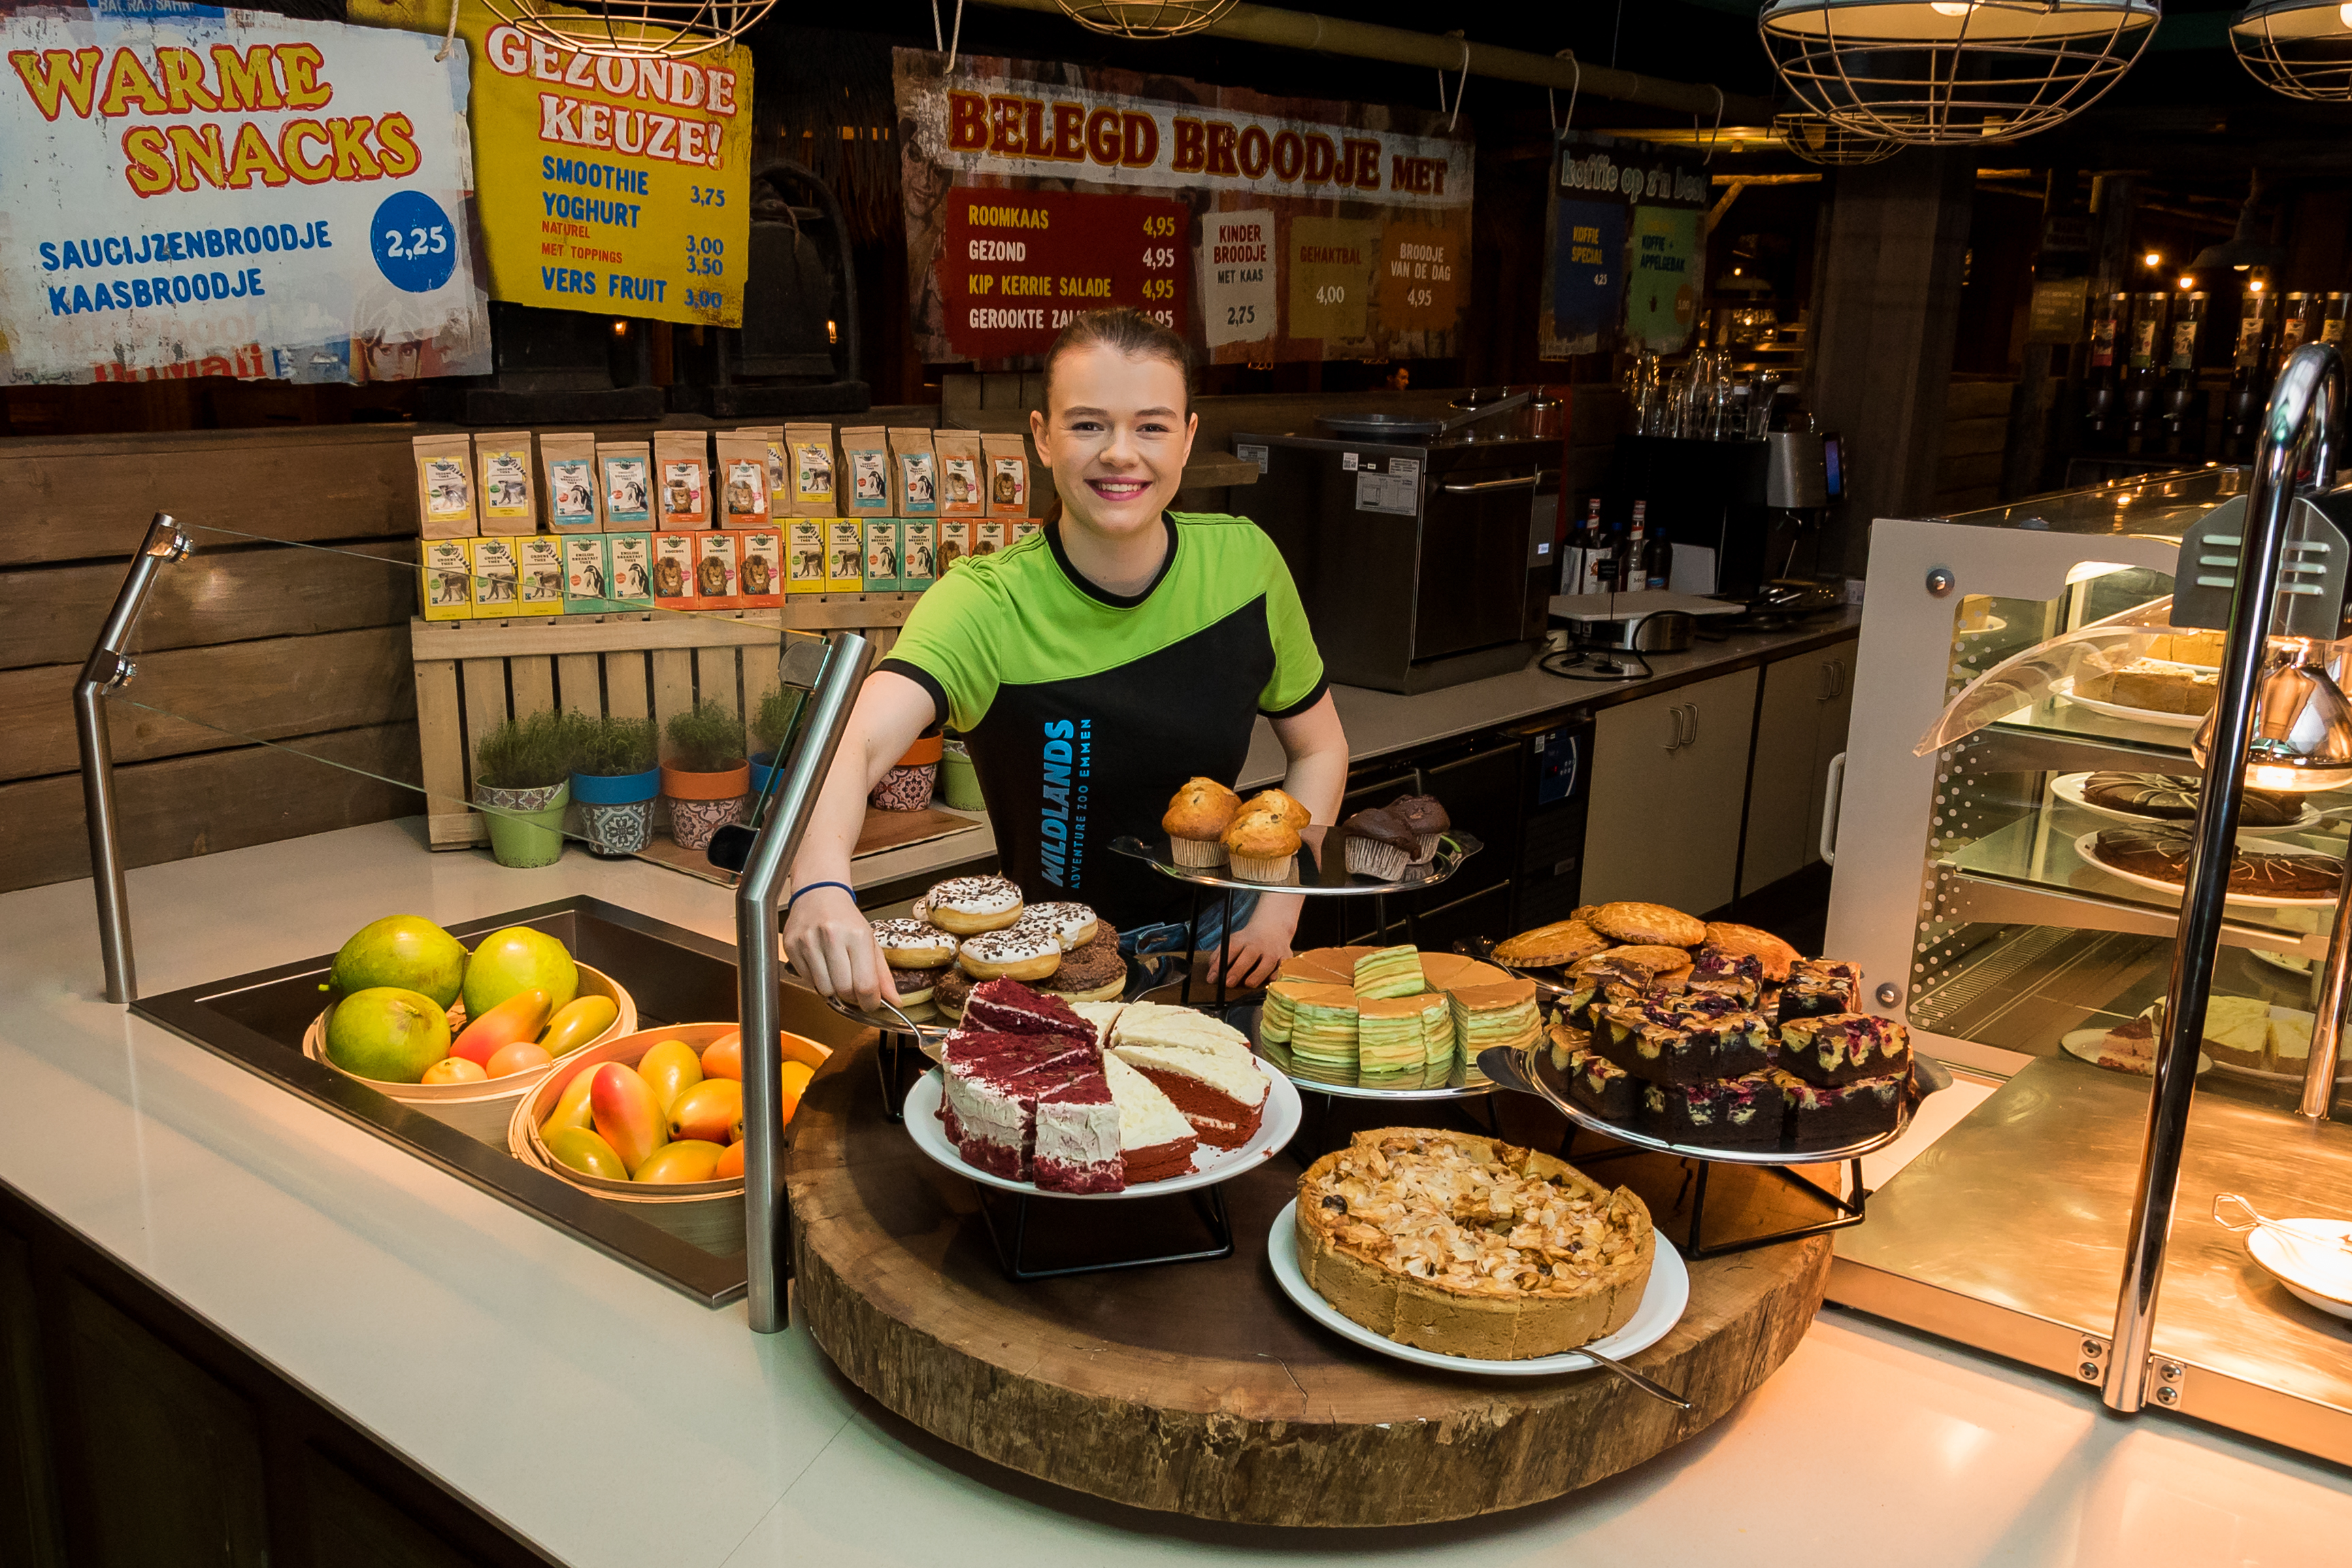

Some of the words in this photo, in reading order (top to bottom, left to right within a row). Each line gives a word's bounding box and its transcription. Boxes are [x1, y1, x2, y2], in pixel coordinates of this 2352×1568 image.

[484, 23, 737, 117] GEZONDE
[8, 41, 333, 122] WARME
[538, 91, 724, 170] KEUZE!
[947, 88, 1159, 169] BELEGD
[1172, 116, 1382, 191] BROODJE
[1391, 154, 1448, 195] MET
[121, 112, 421, 198] SNACKS
[542, 155, 649, 196] SMOOTHIE
[1621, 167, 1644, 204] op
[690, 186, 725, 207] 3,75
[542, 191, 641, 229] YOGHURT
[969, 205, 1048, 230] ROOMKAAS
[542, 221, 591, 239] NATUREL
[1143, 216, 1175, 239] 4,95
[1219, 224, 1261, 243] KINDER
[1573, 226, 1600, 244] KOFFIE
[39, 220, 333, 271] SAUCIJZENBROODJE
[385, 226, 447, 261] 2,25
[542, 243, 563, 258] MET
[570, 246, 623, 264] TOPPINGS
[686, 235, 724, 256] 3,00
[969, 239, 1026, 262] GEZOND
[1214, 244, 1267, 265] BROODJE
[1399, 242, 1444, 263] BROODJE
[1642, 235, 1666, 252] KOFFIE
[686, 255, 723, 277] 3,50
[1142, 248, 1174, 270] 4,95
[1300, 246, 1361, 265] GEHAKTBAL
[1572, 246, 1603, 265] SPECIAL
[1217, 269, 1236, 284] MET
[1240, 268, 1263, 283] KAAS
[1391, 261, 1410, 278] VAN
[1414, 263, 1427, 280] DE
[1431, 265, 1451, 281] DAG
[49, 268, 265, 316] KAASBROODJE
[542, 265, 596, 296] VERS
[609, 275, 667, 303] FRUIT
[969, 274, 993, 295] KIP
[1001, 275, 1052, 296] KERRIE
[1059, 276, 1111, 297] SALADE
[1142, 279, 1174, 301] 4,95
[684, 289, 723, 309] 3,00
[1316, 286, 1345, 306] 4,00
[1407, 288, 1431, 307] 4,95
[969, 308, 1044, 329] GEROOKTE
[1227, 305, 1255, 327] 2,75
[1079, 719, 1091, 778] EMMEN
[1041, 719, 1074, 888] WILDLANDS
[1077, 786, 1089, 810] ZOO
[1071, 816, 1087, 890] ADVENTURE
